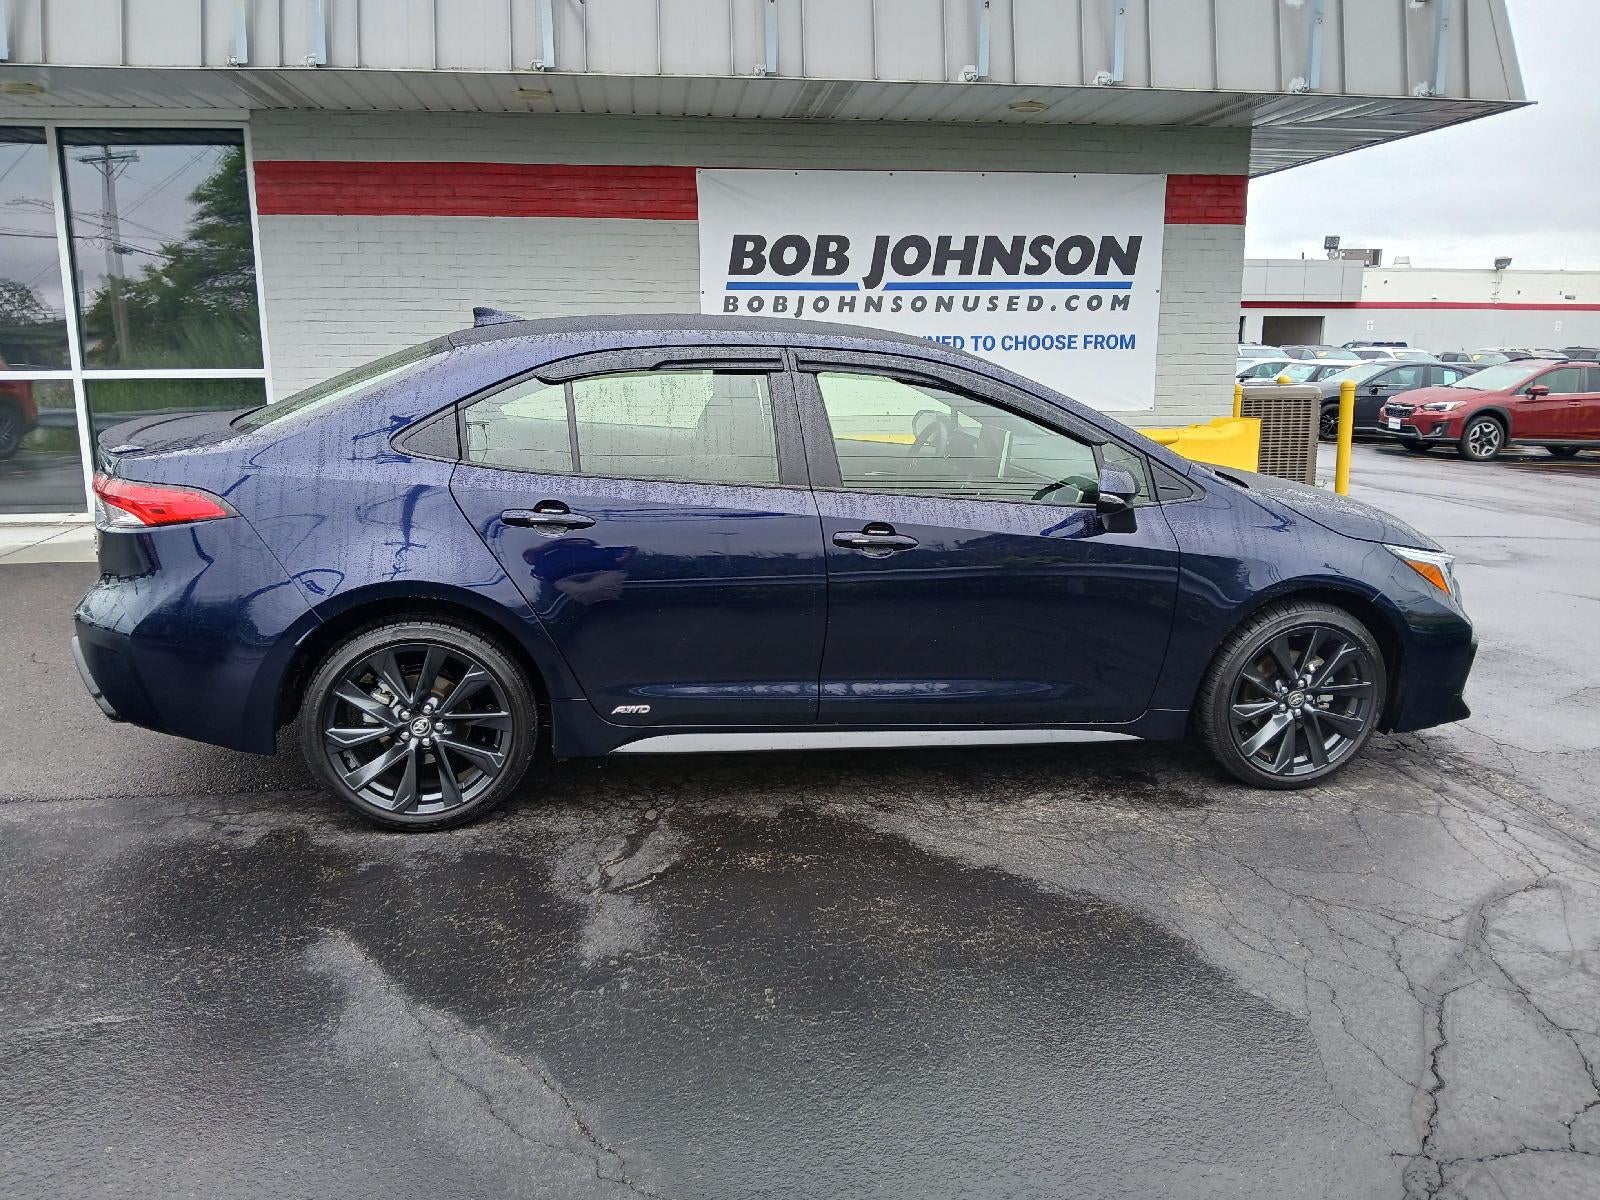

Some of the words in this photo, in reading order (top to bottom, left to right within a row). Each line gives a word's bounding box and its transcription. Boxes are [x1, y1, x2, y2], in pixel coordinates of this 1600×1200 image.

[728, 234, 851, 276] BOB
[862, 234, 1143, 290] JOHNSON
[723, 294, 1131, 318] BOBJOHNSONUSED.COM
[970, 335, 996, 352] TO
[1000, 334, 1079, 351] CHOOSE
[1083, 333, 1136, 350] FROM
[610, 704, 651, 715] AWD
